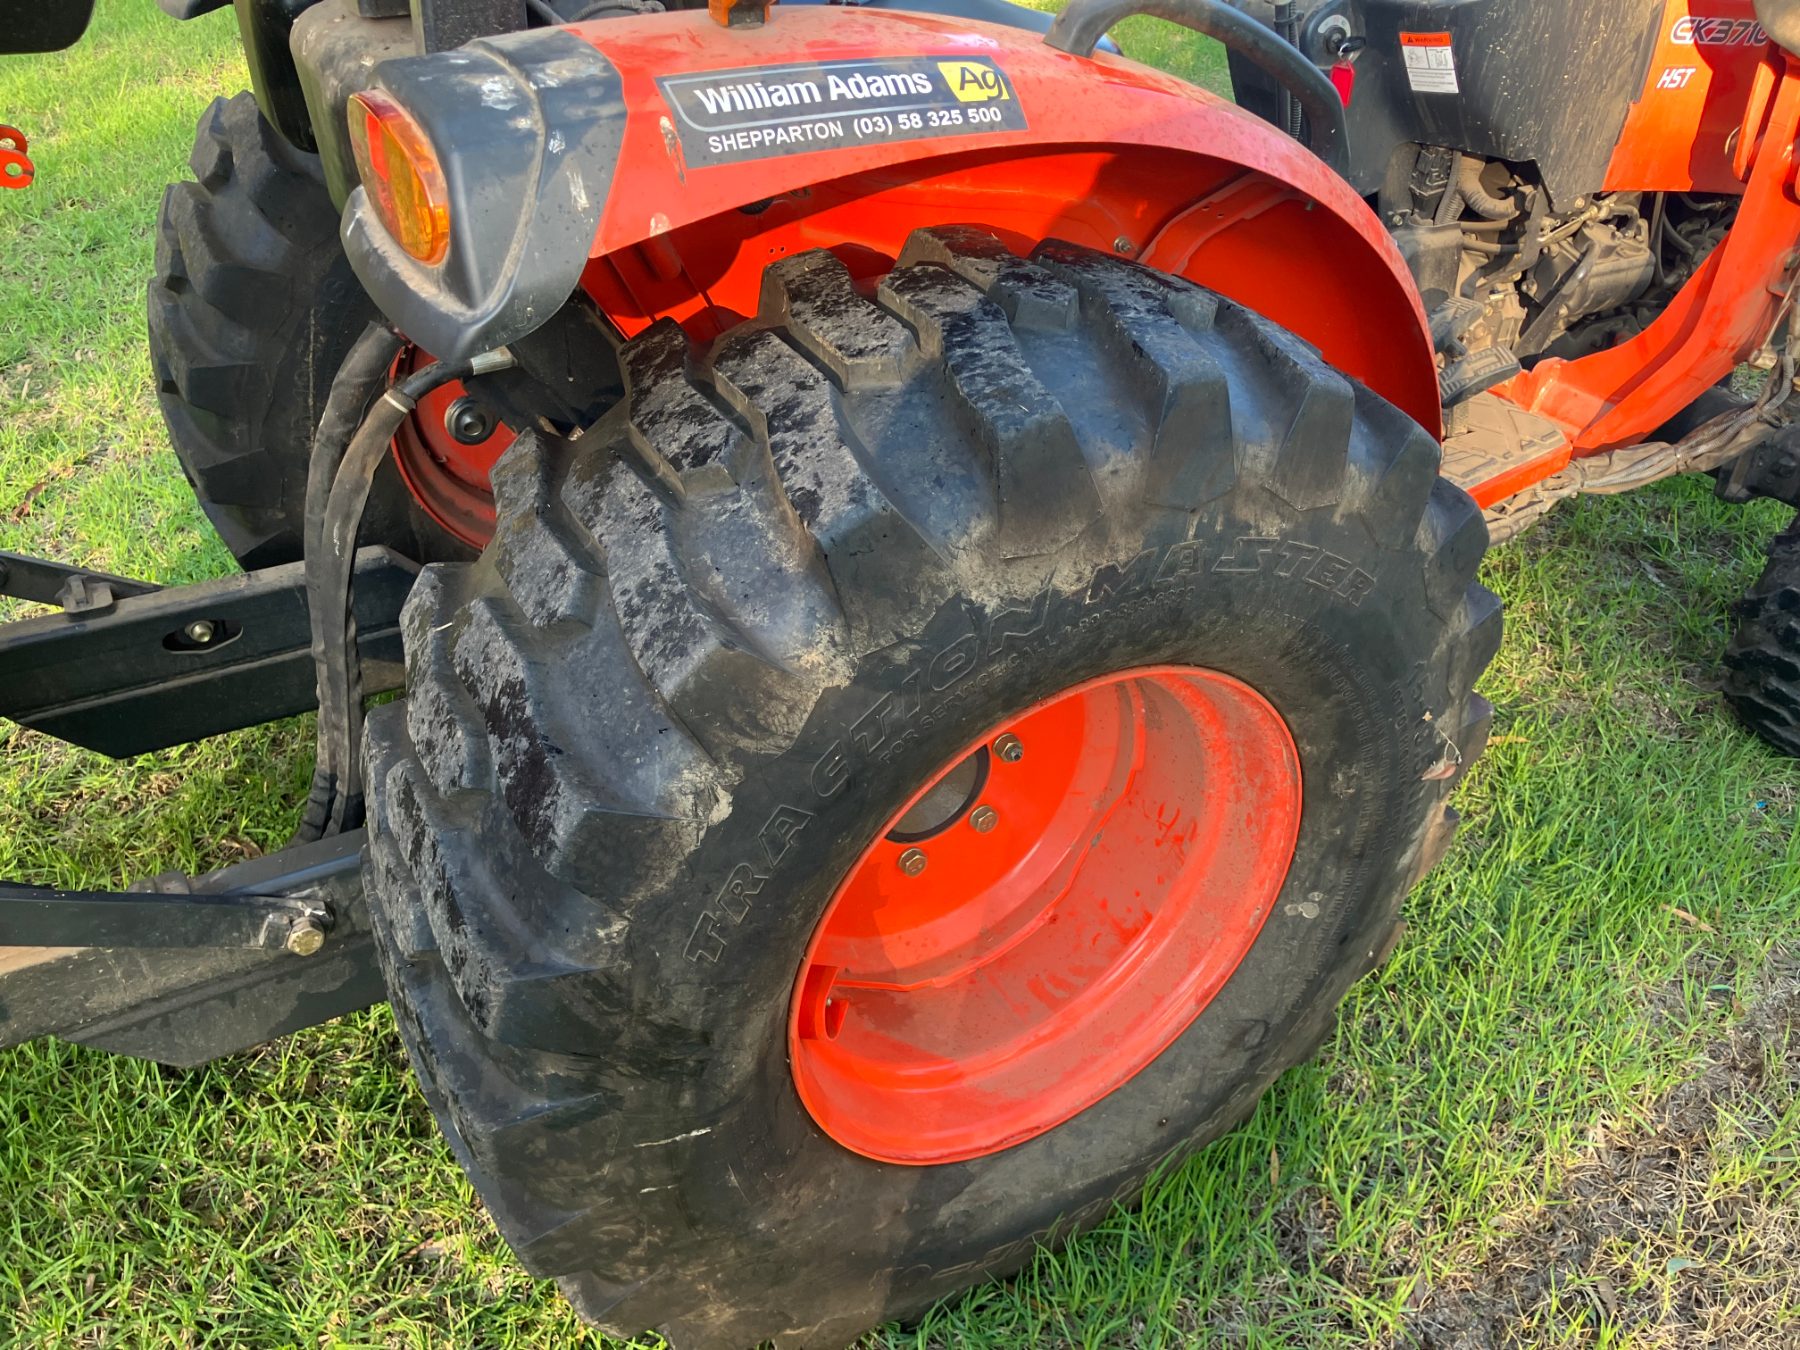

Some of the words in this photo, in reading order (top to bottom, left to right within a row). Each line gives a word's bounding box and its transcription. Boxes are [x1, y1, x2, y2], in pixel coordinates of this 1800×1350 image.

[694, 80, 822, 114] William
[826, 72, 933, 102] Adams
[959, 66, 1005, 100] Ag
[1656, 68, 1696, 89] HST
[708, 121, 845, 154] SHEPPARTON
[853, 114, 893, 138] (03)
[898, 112, 924, 130] 58
[928, 109, 963, 127] 325
[968, 106, 1002, 123] 500
[878, 728, 920, 765] FOR
